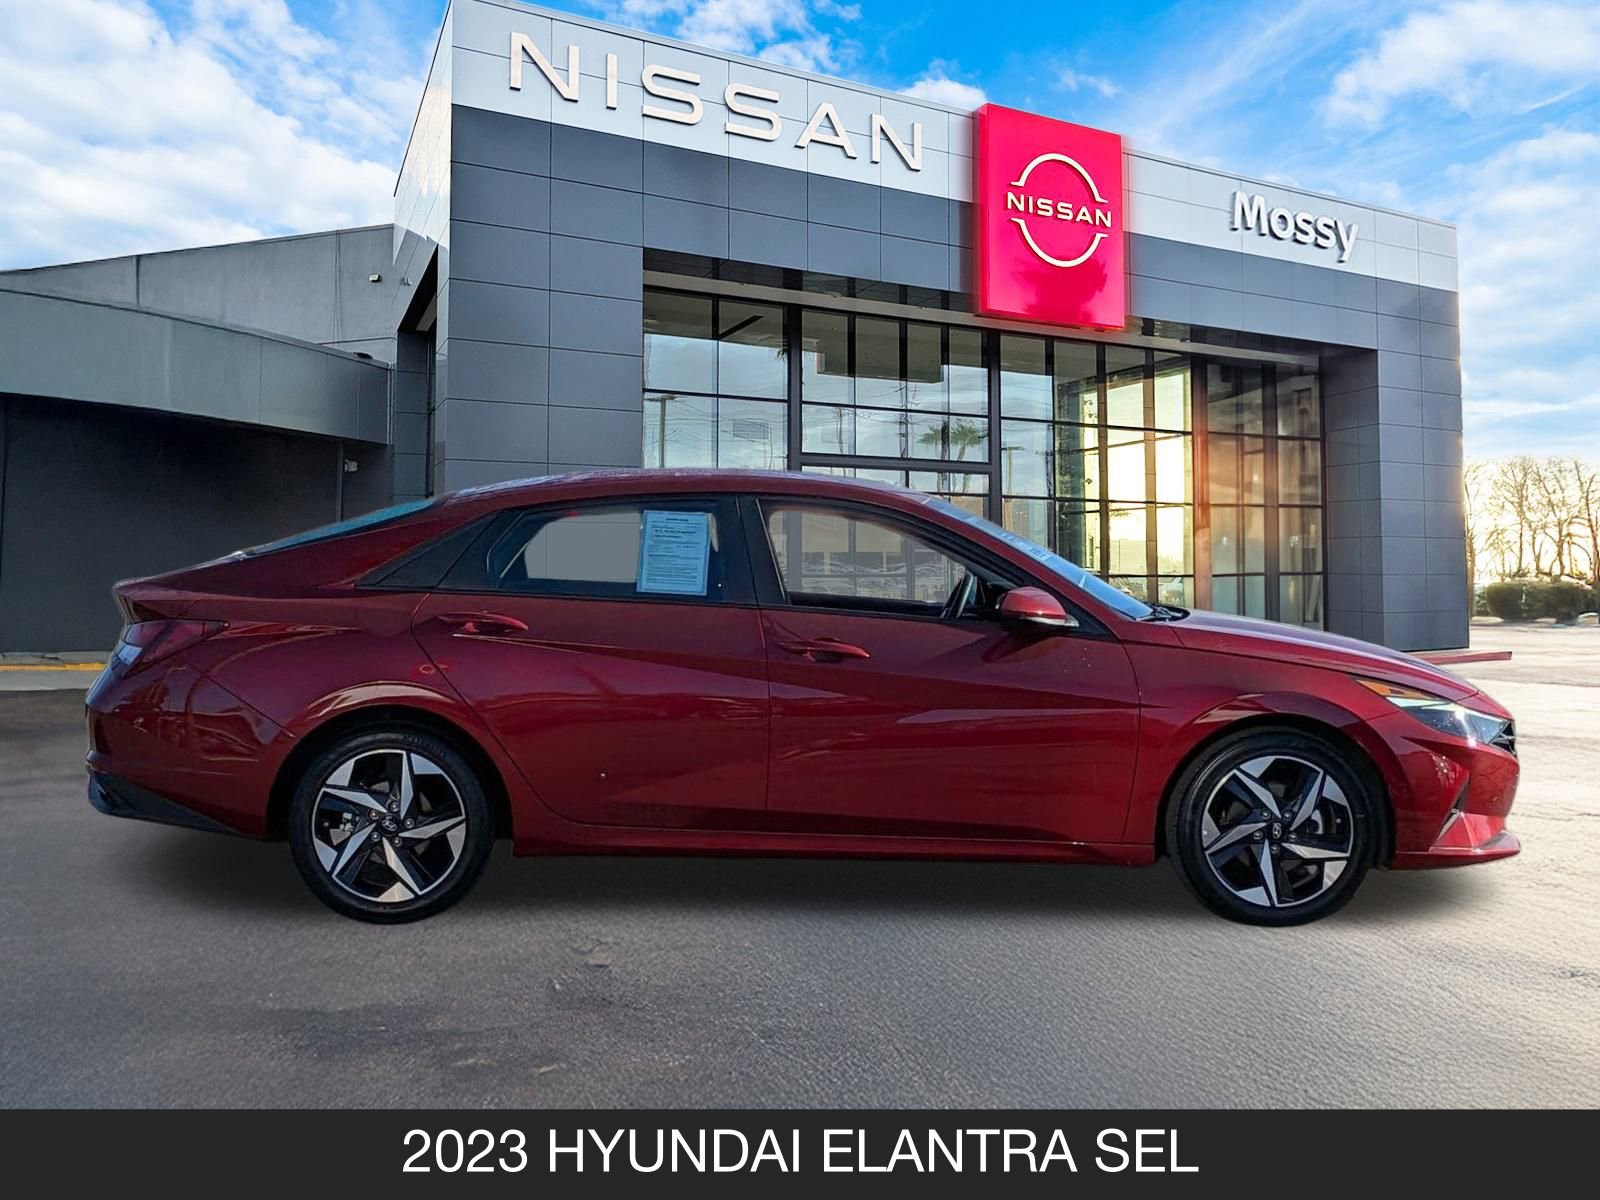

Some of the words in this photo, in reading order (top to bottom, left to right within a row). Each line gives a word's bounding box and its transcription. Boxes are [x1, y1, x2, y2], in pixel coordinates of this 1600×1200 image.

[509, 32, 922, 171] NISSAN
[1006, 191, 1112, 228] NISSAN
[1231, 190, 1360, 263] Mossy
